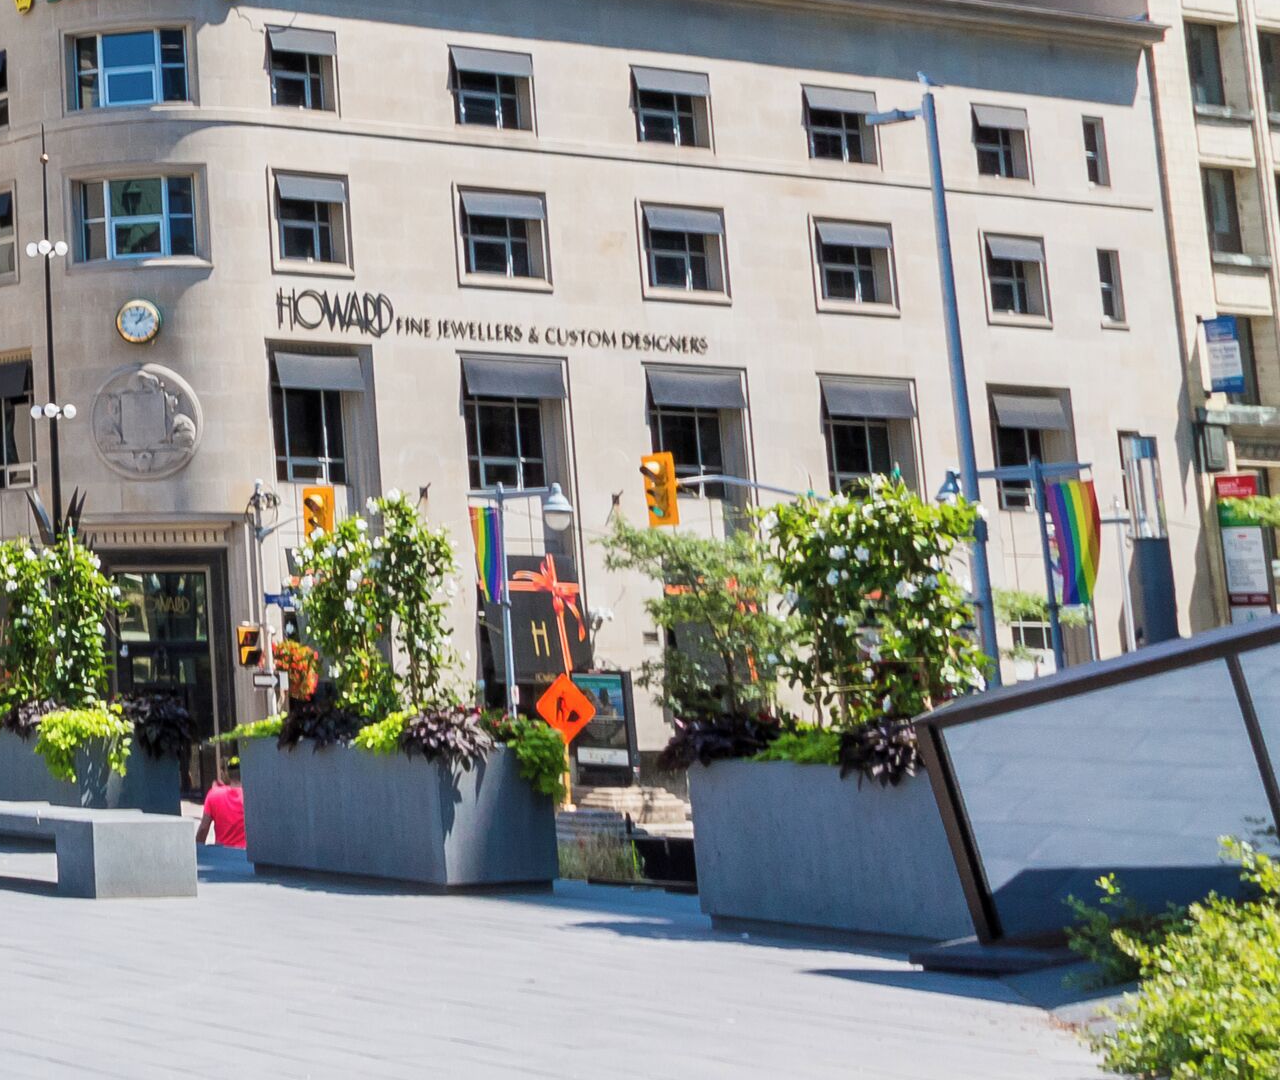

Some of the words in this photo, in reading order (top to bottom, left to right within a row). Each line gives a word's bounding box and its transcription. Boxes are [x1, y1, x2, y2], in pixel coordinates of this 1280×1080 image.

[275, 286, 394, 339] HOWARD
[396, 316, 432, 339] FINE
[437, 317, 523, 344] JEWELLERS
[528, 326, 540, 345] &
[545, 327, 617, 349] CUSTOM
[621, 332, 709, 356] DESIGNERS
[530, 619, 551, 658] H
